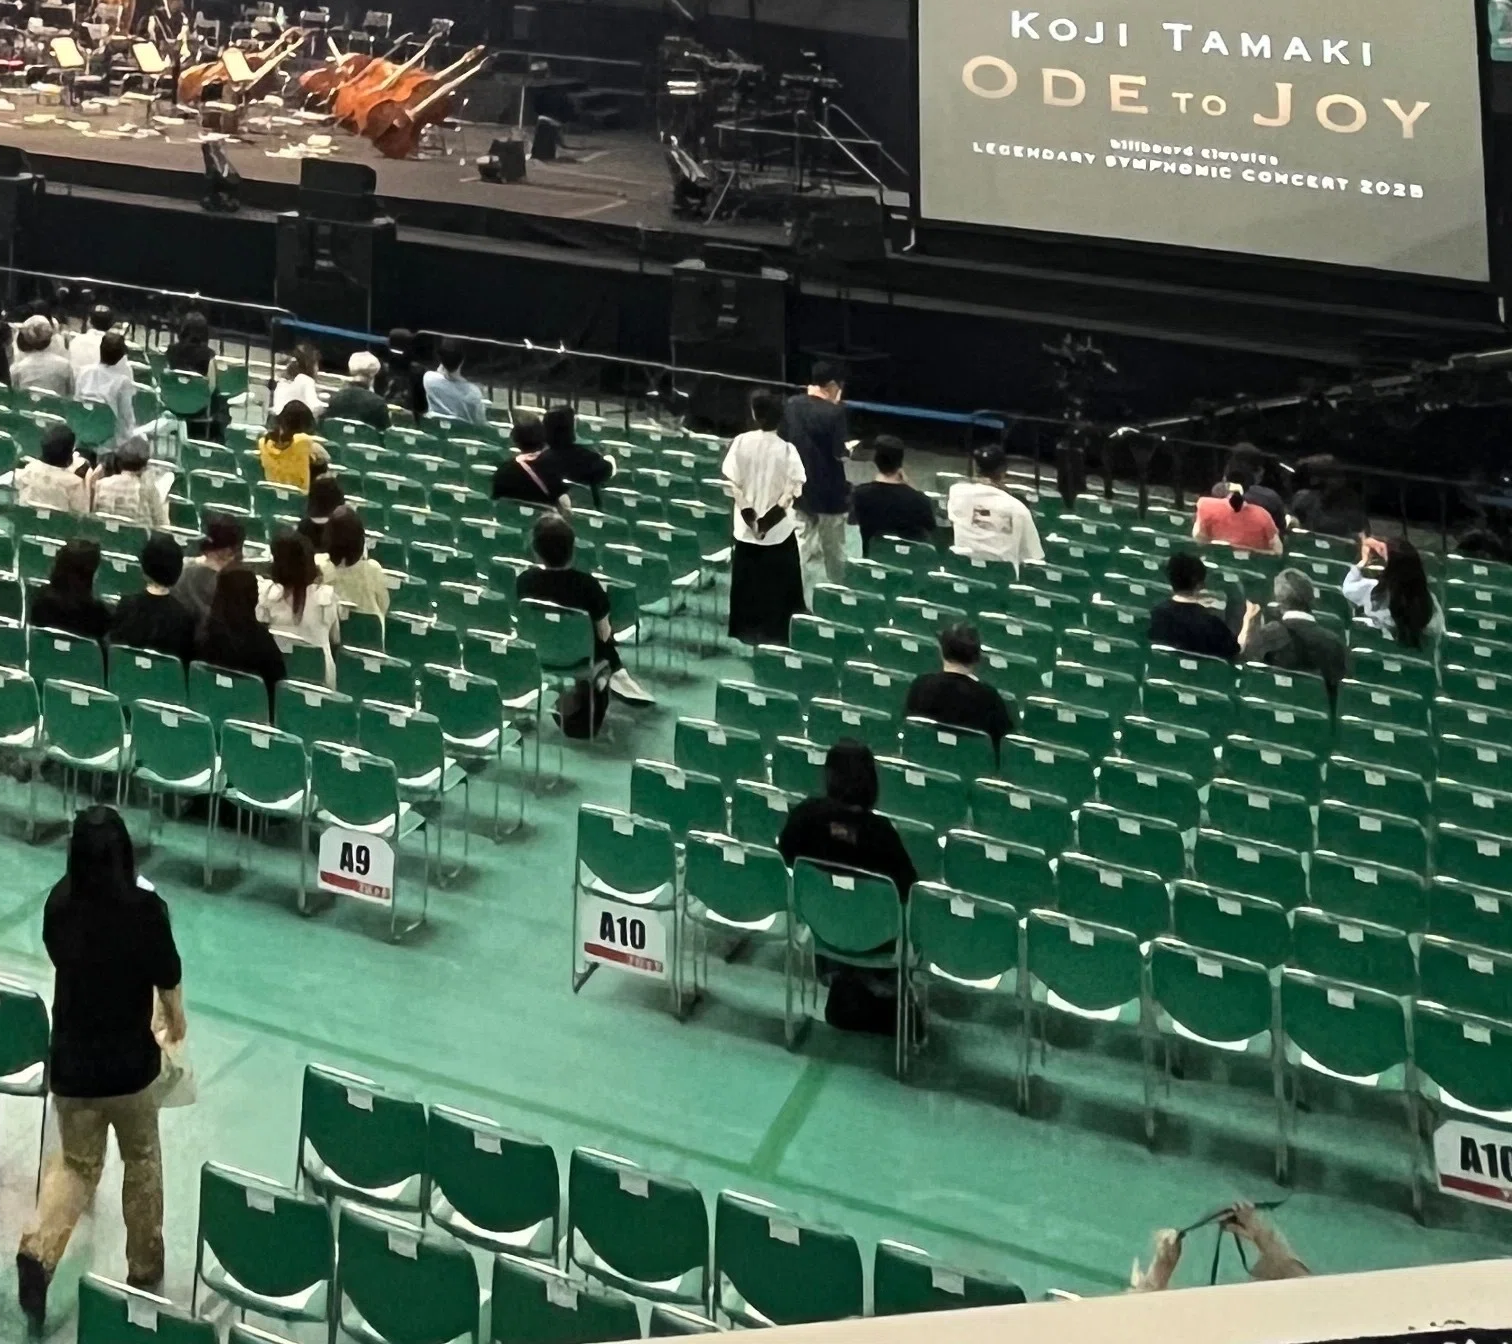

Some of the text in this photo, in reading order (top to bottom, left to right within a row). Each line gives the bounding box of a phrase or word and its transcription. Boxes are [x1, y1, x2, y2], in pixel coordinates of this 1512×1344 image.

[1010, 9, 1373, 67] KOJI TAMAKI
[961, 55, 1149, 115] ODE
[1253, 82, 1431, 140] JOY
[972, 141, 1096, 164] LEGENDARY
[1105, 155, 1232, 179] SYMPHONIC
[1241, 169, 1349, 192] CONCERT
[339, 842, 371, 876] A9
[599, 911, 646, 950] A10
